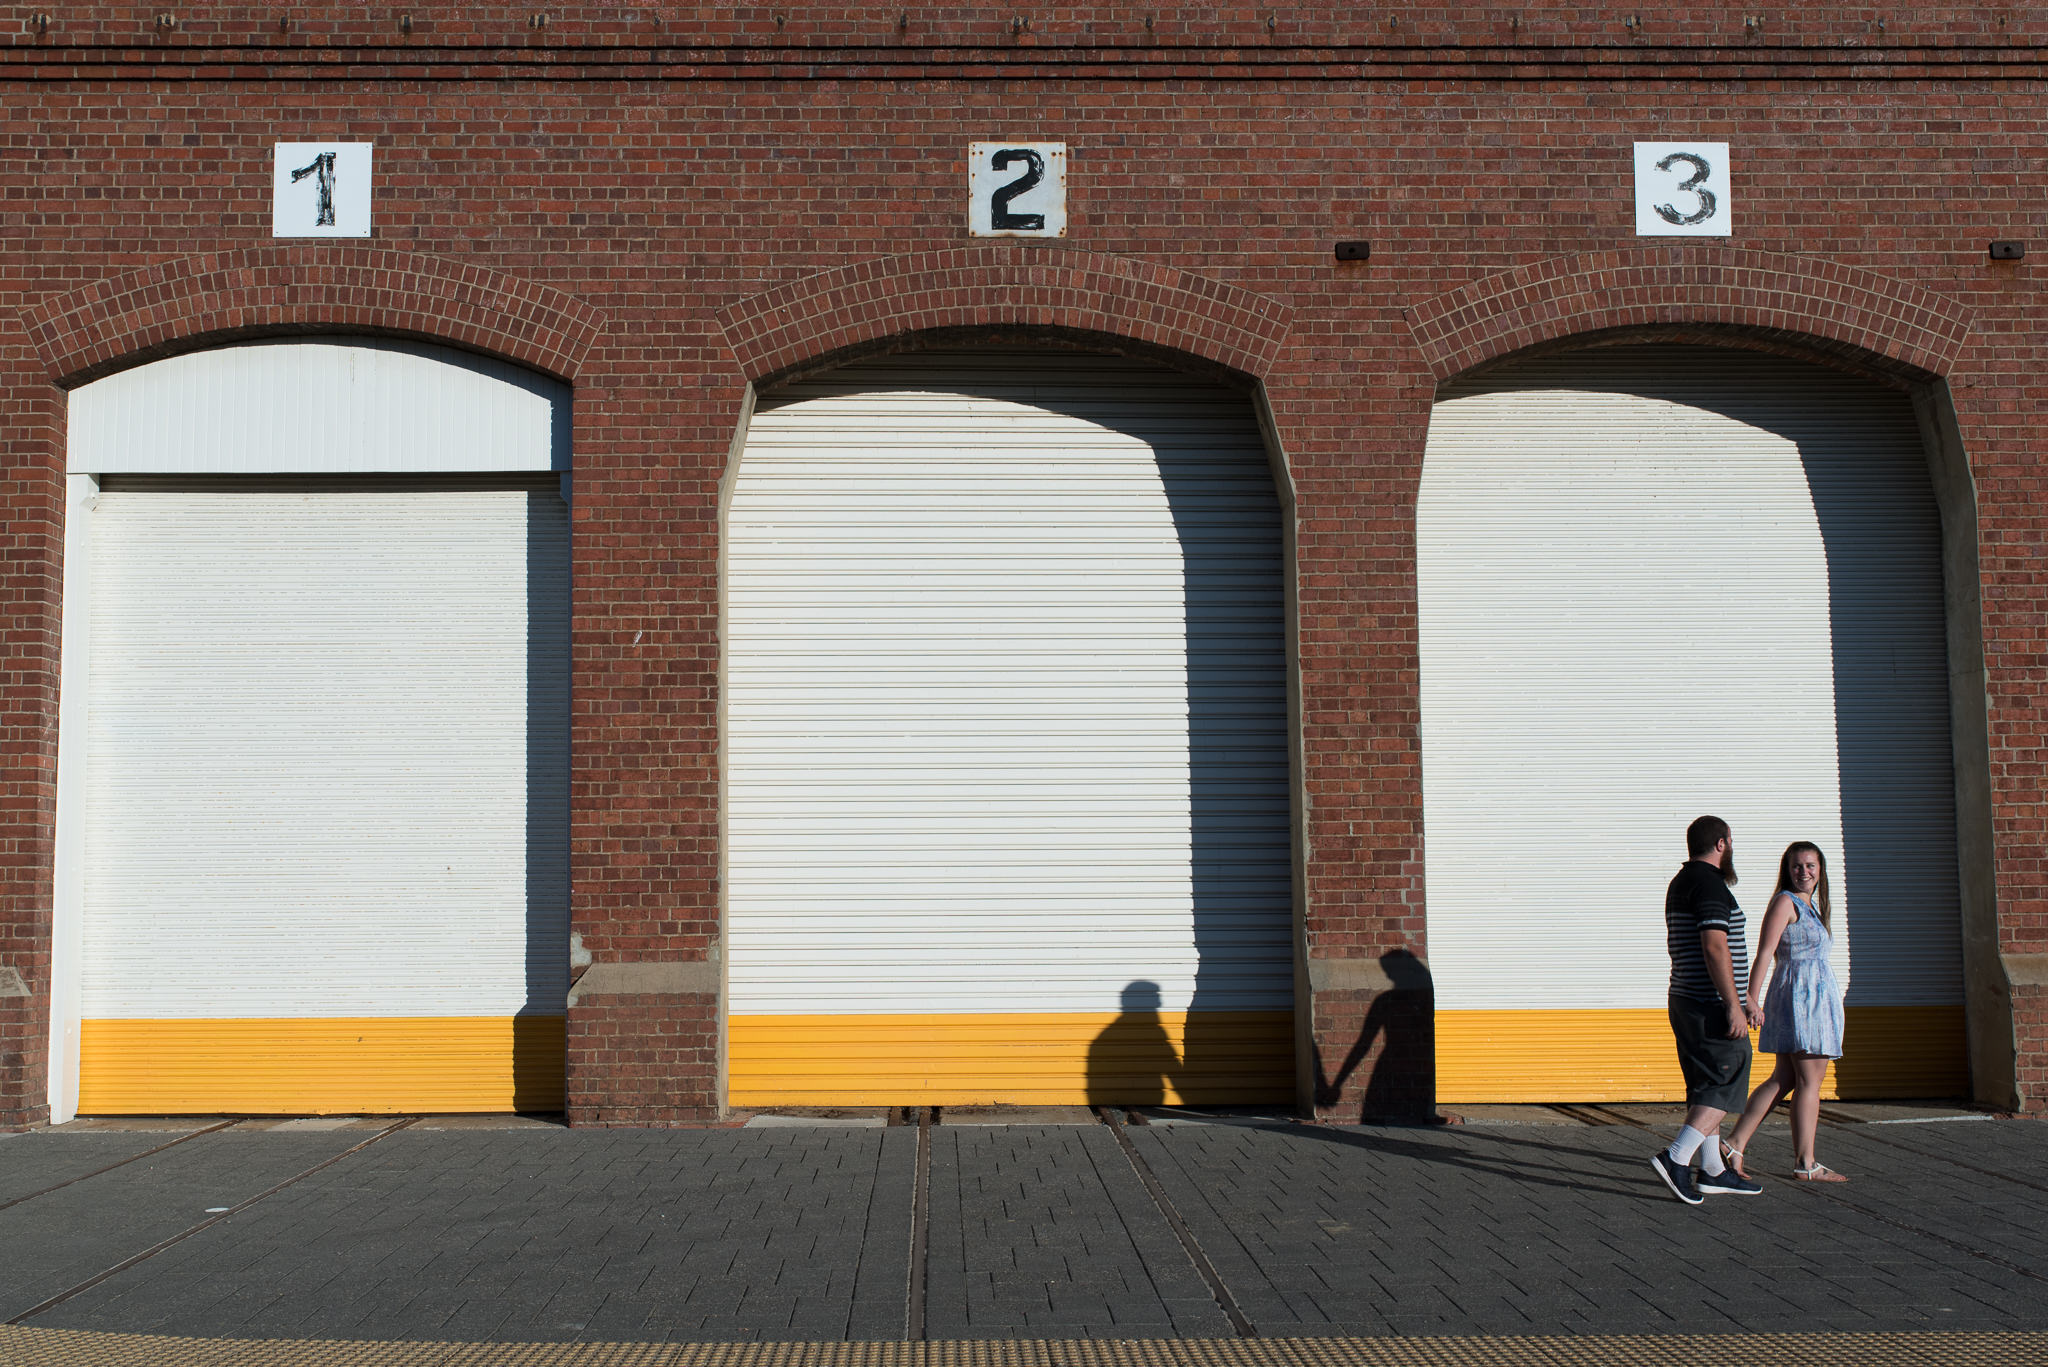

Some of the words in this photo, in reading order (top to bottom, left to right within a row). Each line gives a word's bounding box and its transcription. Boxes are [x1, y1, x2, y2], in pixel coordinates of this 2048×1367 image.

[291, 152, 337, 226] 1
[991, 149, 1045, 230] 2
[1653, 152, 1717, 226] 3
